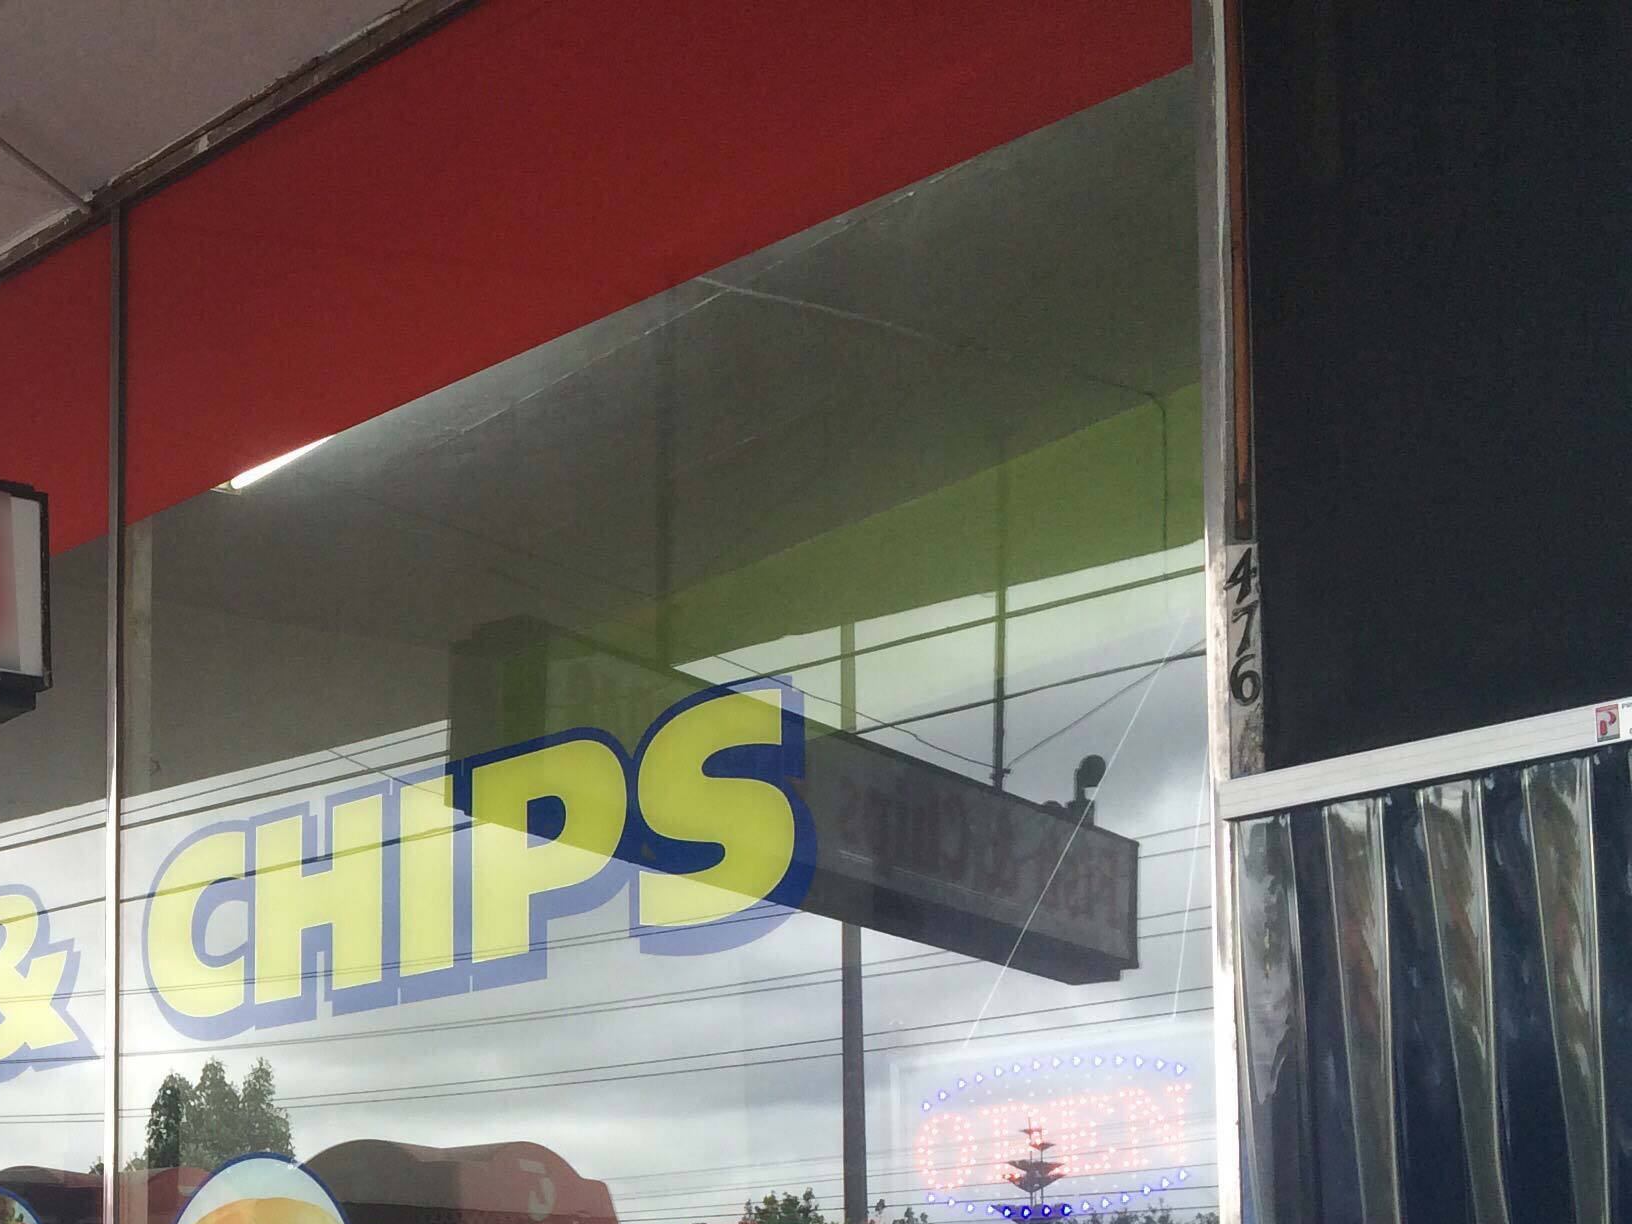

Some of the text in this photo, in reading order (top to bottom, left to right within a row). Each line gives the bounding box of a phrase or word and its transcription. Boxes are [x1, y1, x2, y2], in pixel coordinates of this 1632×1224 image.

[1224, 547, 1261, 706] 476
[144, 676, 817, 1041] CHIPS
[917, 1080, 1193, 1192] OPEN
